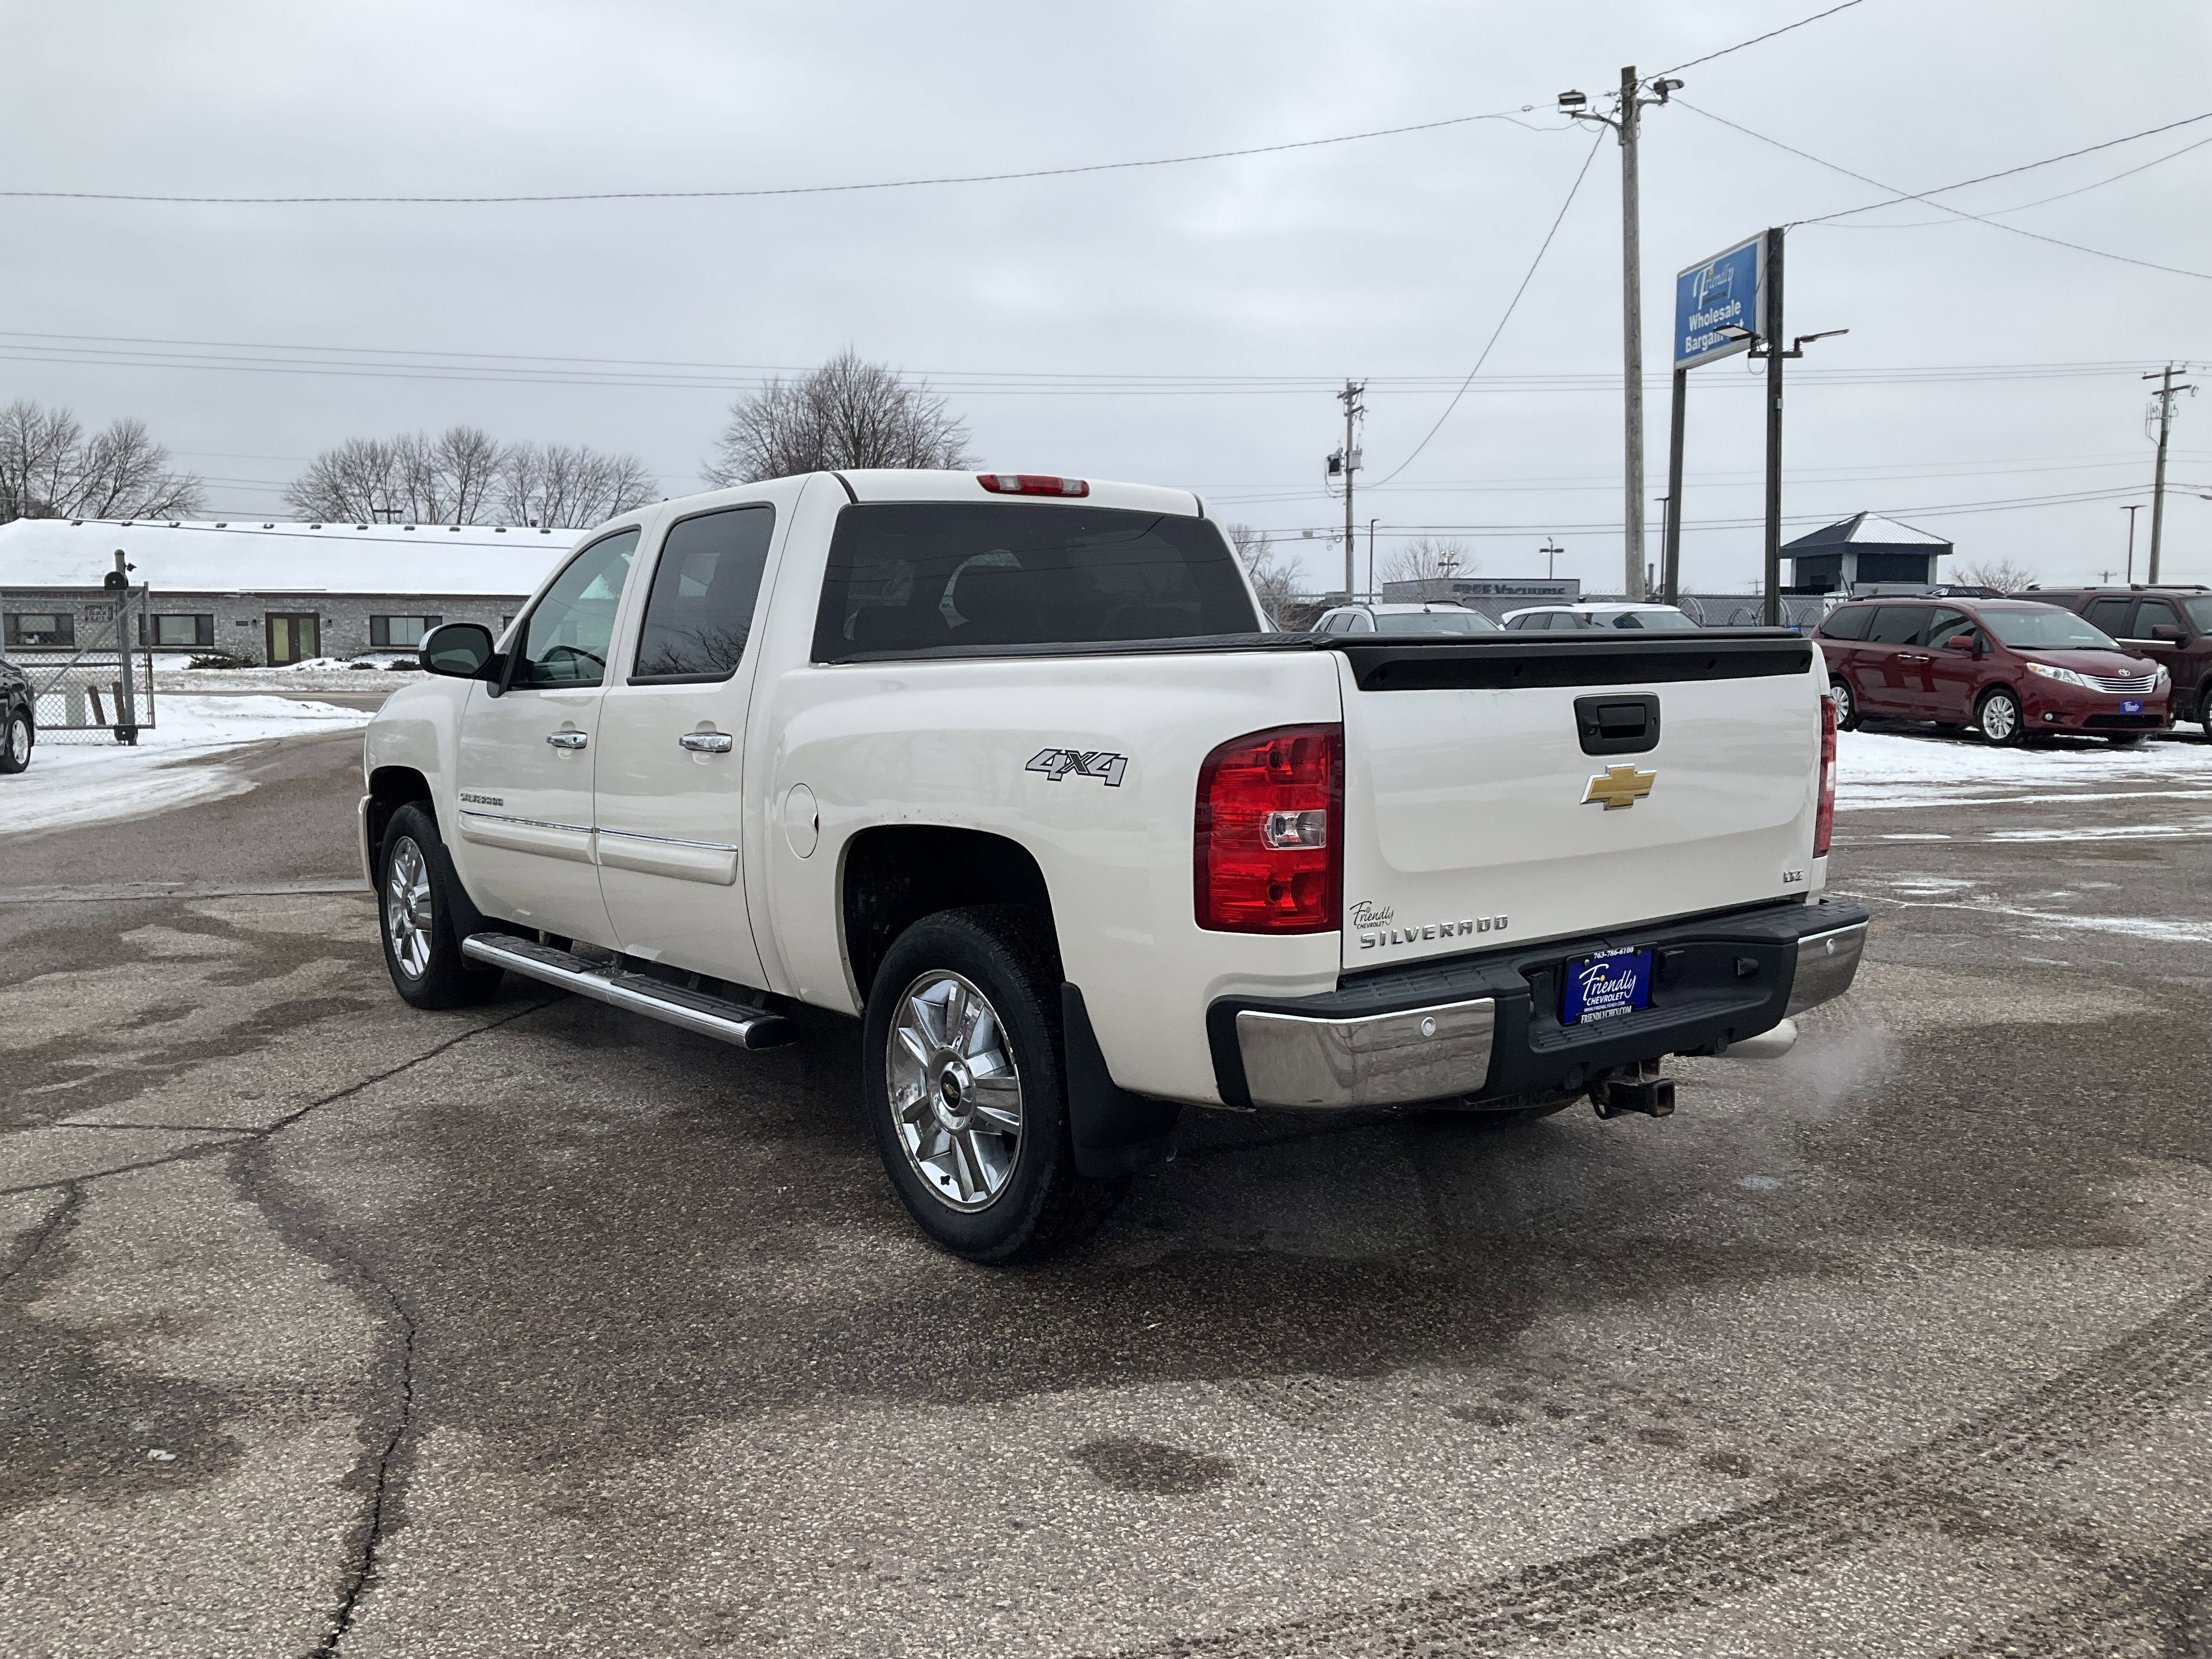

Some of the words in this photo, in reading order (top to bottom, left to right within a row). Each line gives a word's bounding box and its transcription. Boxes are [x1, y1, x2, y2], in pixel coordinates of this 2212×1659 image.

[1689, 300, 1741, 331] Wholesale
[1453, 584, 1491, 594] FREE
[1494, 584, 1565, 594] Vacuums
[1350, 901, 1393, 926] Friendly
[1357, 921, 1385, 929] CHEVROLET
[1360, 915, 1508, 949] SILVERADO
[1594, 946, 1634, 959] 763-786-6100
[1579, 963, 1636, 1001] Friendly
[1587, 991, 1624, 1006] CHEVROLET
[1581, 1006, 1632, 1024] FRIENDLYCHEV.COM
